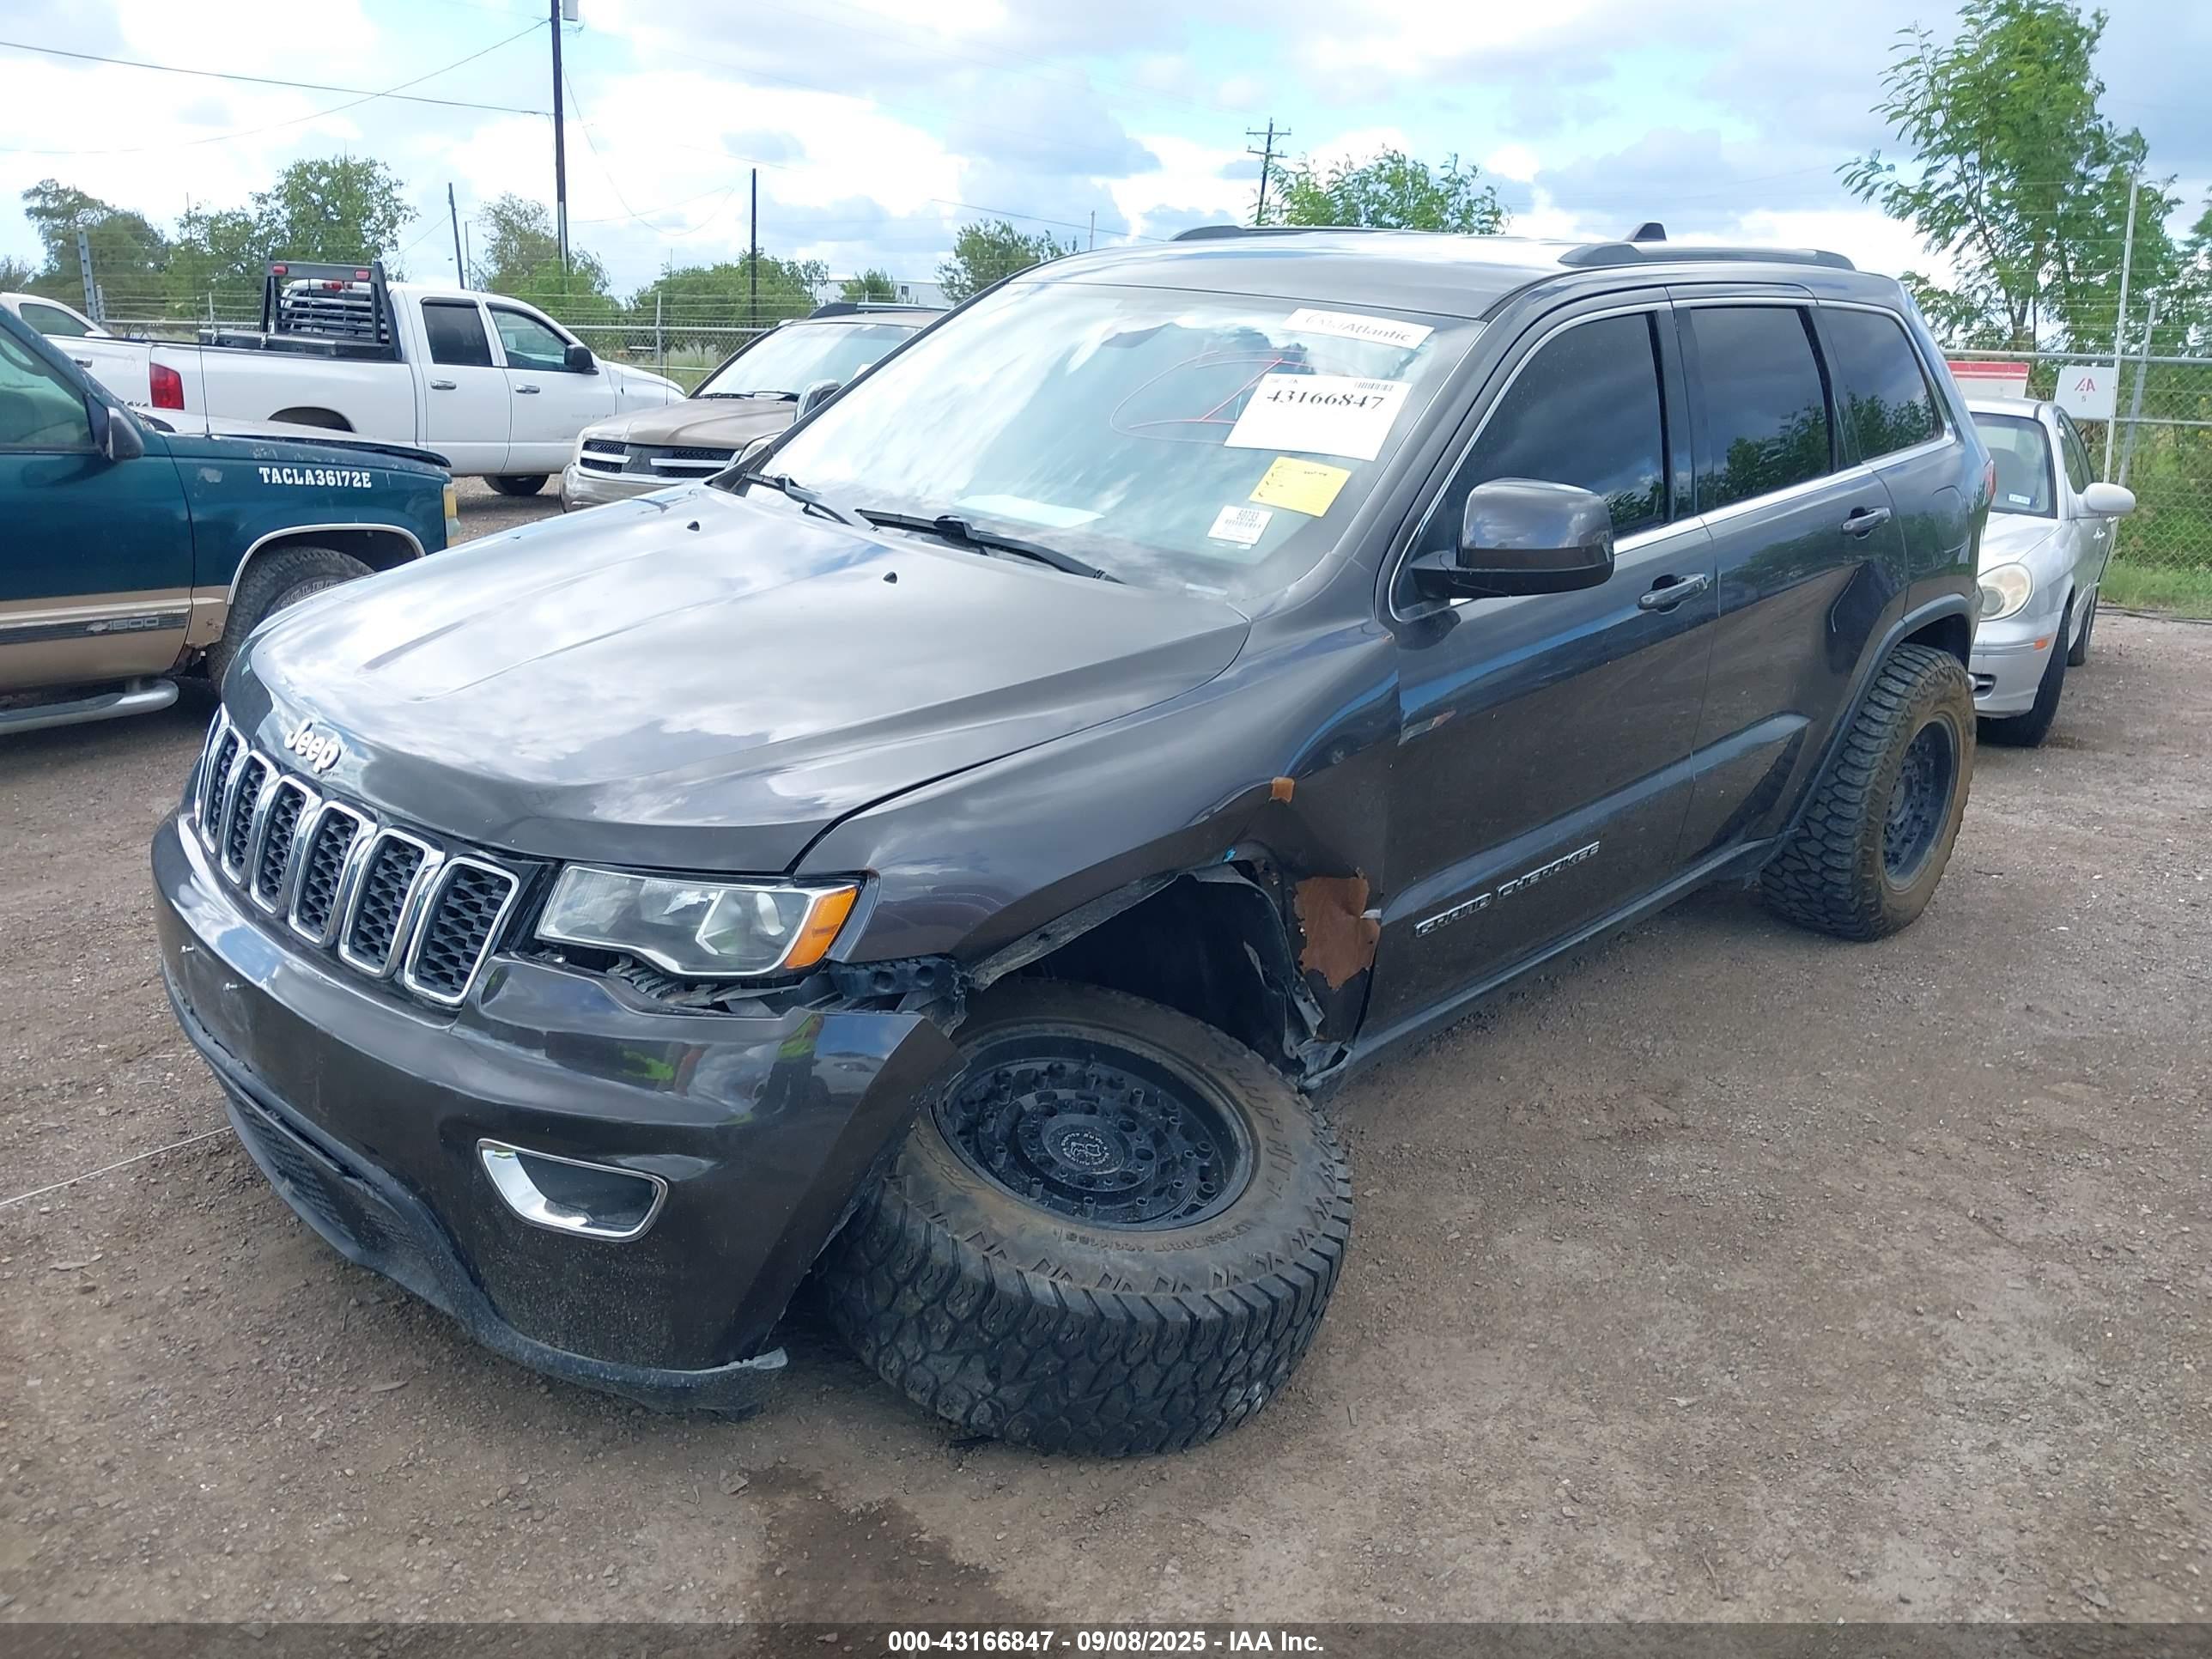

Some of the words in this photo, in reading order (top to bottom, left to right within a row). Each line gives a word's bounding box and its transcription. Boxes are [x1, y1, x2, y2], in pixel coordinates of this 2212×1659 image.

[1267, 390, 1385, 410] 43166847
[258, 466, 372, 489] TACLA36172E
[283, 718, 342, 775] Jeep
[1414, 892, 1492, 938] GRAND
[1497, 841, 1601, 901] CHEROKEE
